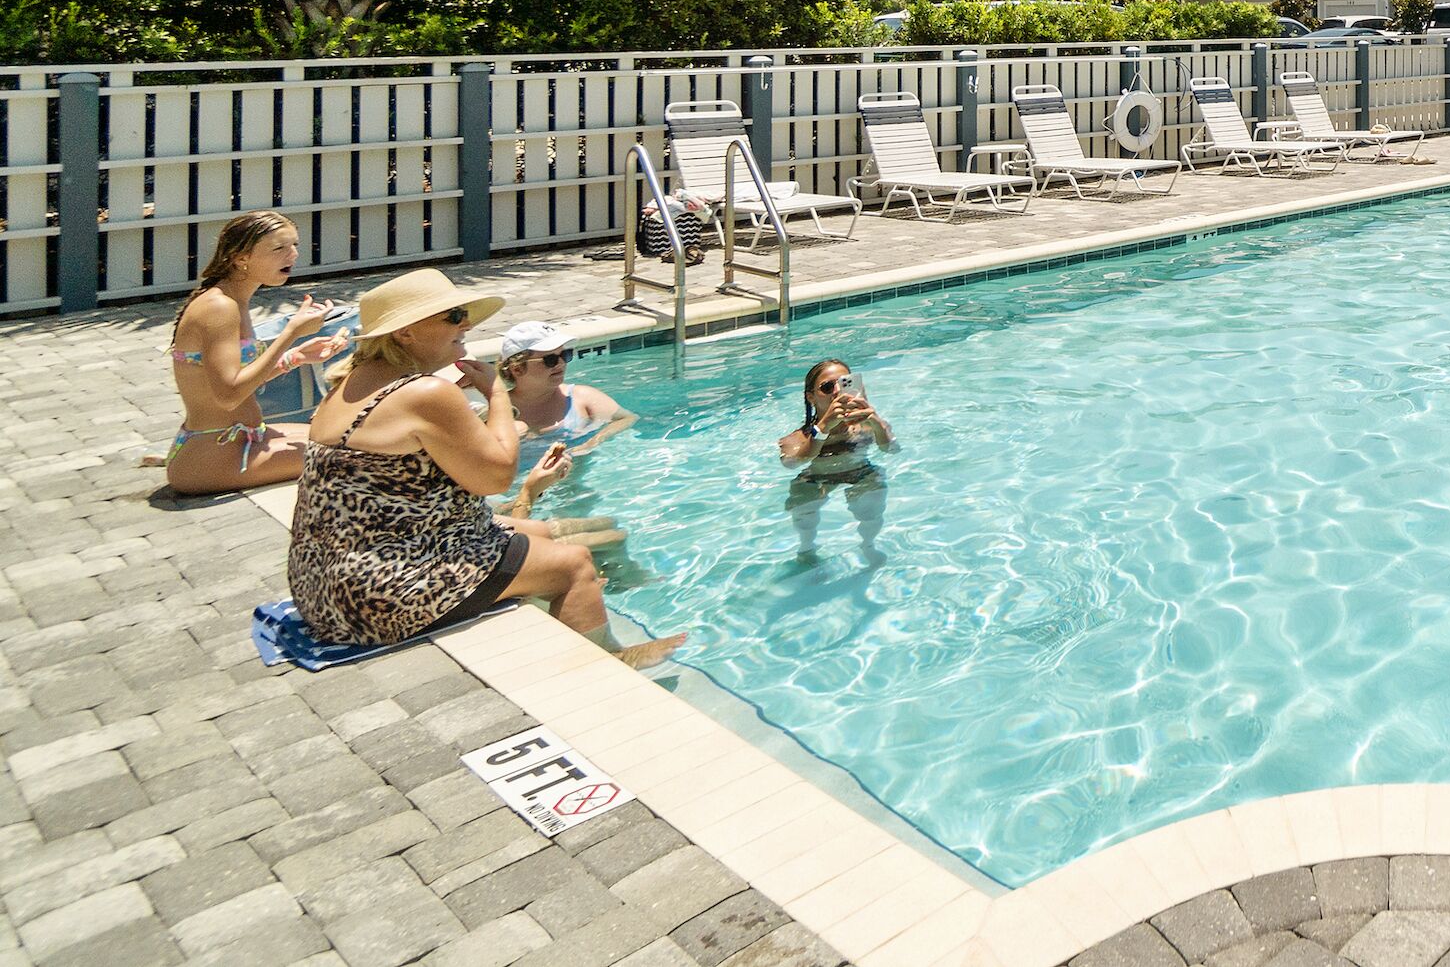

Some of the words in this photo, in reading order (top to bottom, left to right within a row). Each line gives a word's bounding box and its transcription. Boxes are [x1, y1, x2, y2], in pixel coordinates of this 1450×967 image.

[486, 737, 550, 766] 5
[505, 756, 588, 801] FT.
[524, 802, 545, 814] NO
[534, 810, 567, 832] DIVING
